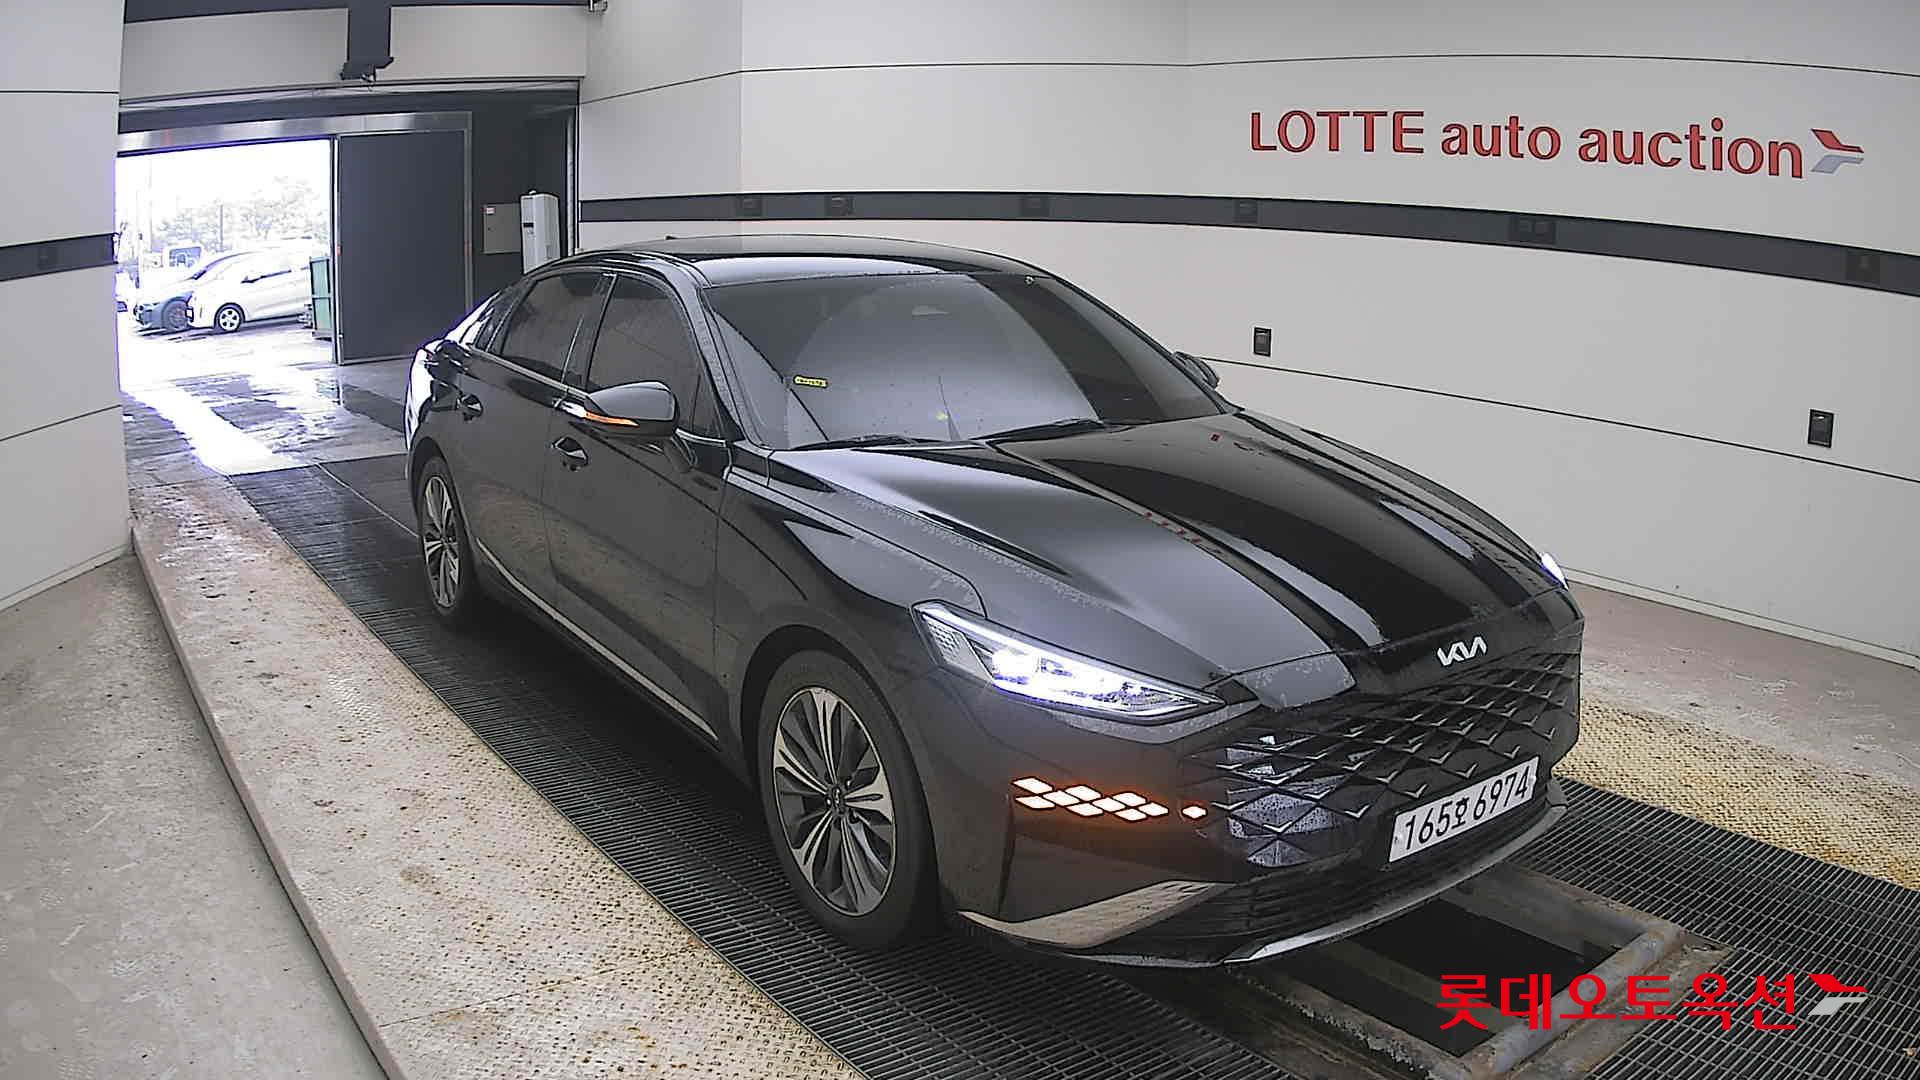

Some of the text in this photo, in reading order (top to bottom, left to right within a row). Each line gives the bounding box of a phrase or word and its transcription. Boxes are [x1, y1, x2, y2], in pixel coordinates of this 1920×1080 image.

[1249, 110, 1805, 179] LOTTE auto auction
[1437, 636, 1487, 666] KIA
[1473, 765, 1531, 821] 6974
